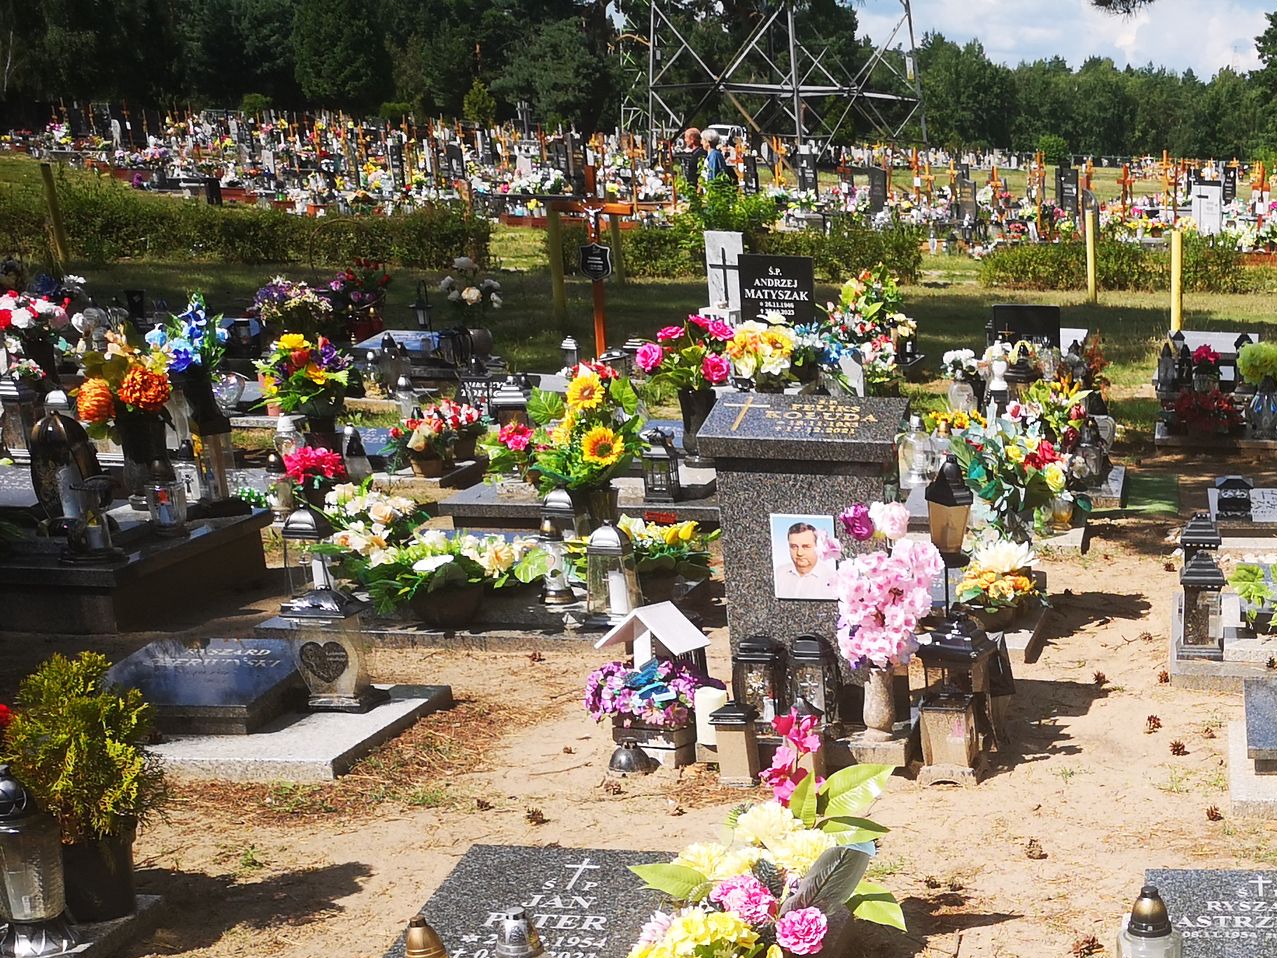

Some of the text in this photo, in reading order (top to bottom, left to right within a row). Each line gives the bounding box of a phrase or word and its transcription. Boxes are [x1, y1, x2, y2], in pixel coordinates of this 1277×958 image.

[753, 278, 798, 288] ANDRZEJ
[744, 288, 809, 301] MATYSZAK
[790, 403, 861, 412] FELIKS
[521, 894, 597, 909] JAN
[480, 911, 608, 931] PTER
